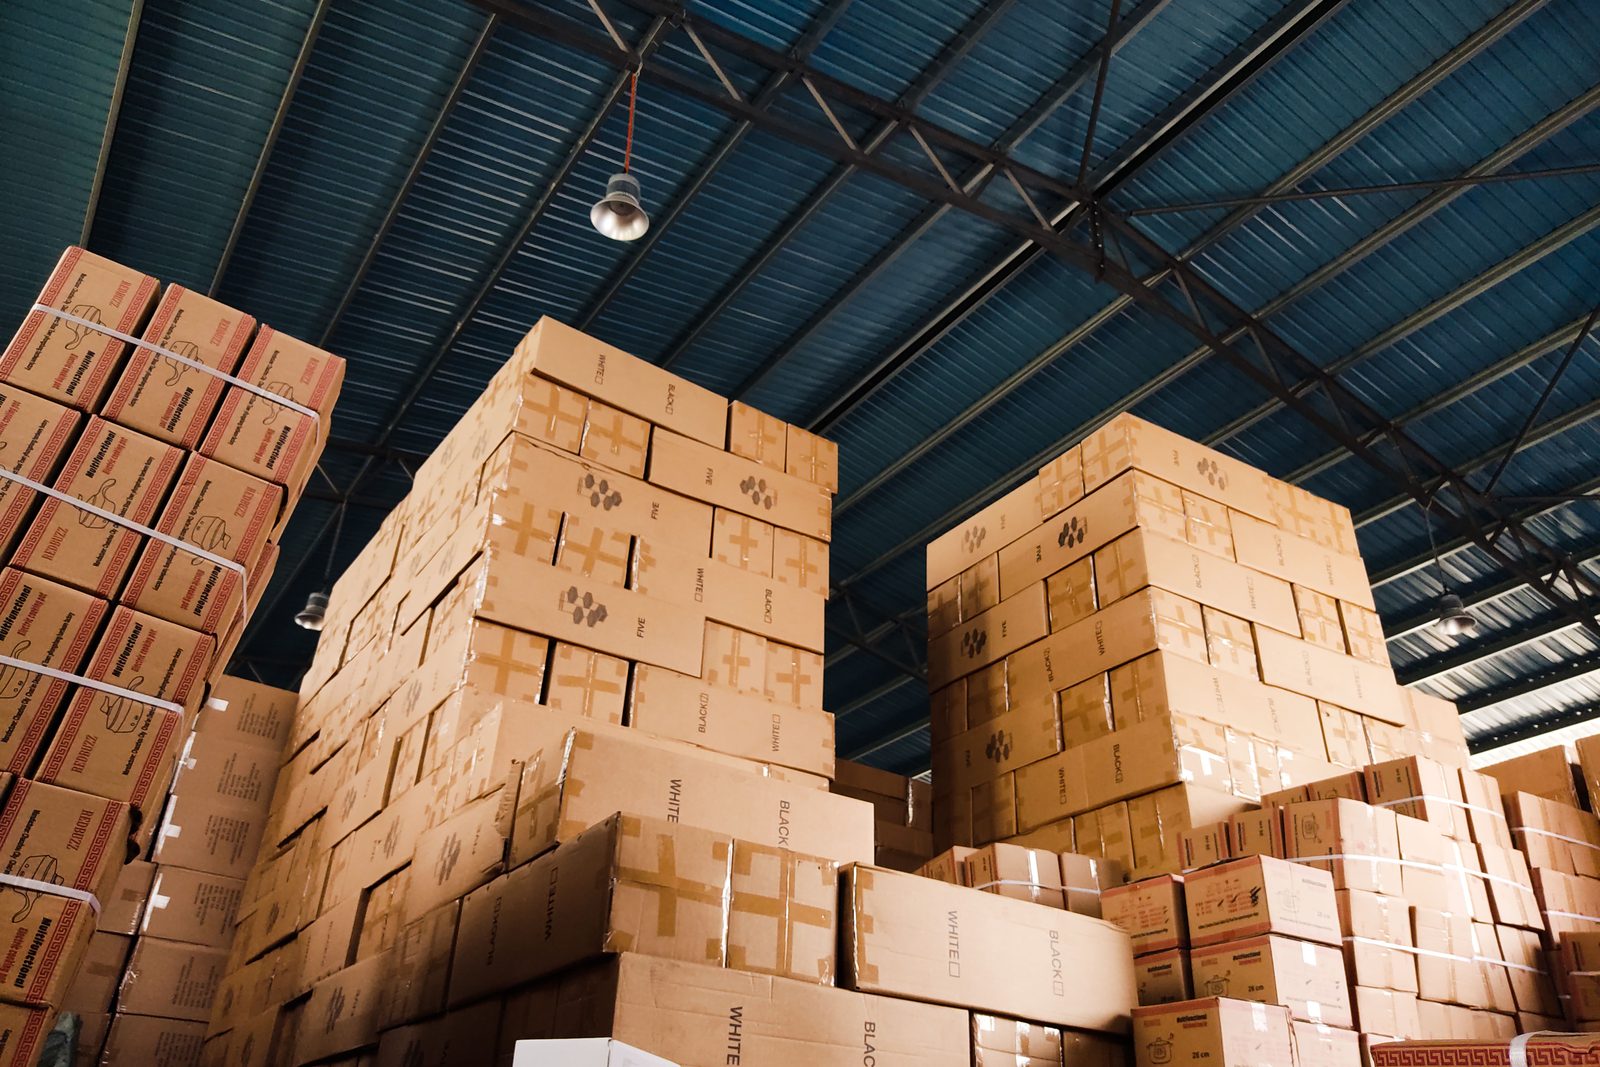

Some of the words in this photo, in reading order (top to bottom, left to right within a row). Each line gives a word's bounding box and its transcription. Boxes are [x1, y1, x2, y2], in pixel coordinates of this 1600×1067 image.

[66, 350, 96, 396] Multifunctional
[597, 354, 606, 377] WHITE
[166, 387, 194, 433] Multifunctional
[666, 384, 676, 406] BLACK
[86, 429, 116, 478] Multifunctional
[706, 468, 714, 486] FIVE
[651, 502, 660, 520] FIVE
[192, 565, 222, 616] Multifunctional
[696, 568, 704, 592] WHITE
[764, 588, 772, 616] BLACK
[637, 618, 646, 638] FIVE
[1096, 631, 1104, 656] WHITE
[112, 622, 143, 678] Multifunctional
[1044, 656, 1054, 682] BLACK
[698, 702, 708, 734] BLACK
[772, 724, 780, 752] WHITE
[1114, 744, 1122, 773] BLACK
[666, 779, 682, 824] WHITE
[66, 808, 93, 851] REDBUZZ
[778, 800, 790, 847] BLACK
[14, 917, 52, 989] Multifunctional
[948, 910, 960, 960] WHITE
[1049, 930, 1062, 980] BLACK
[726, 1006, 742, 1066] WHITE
